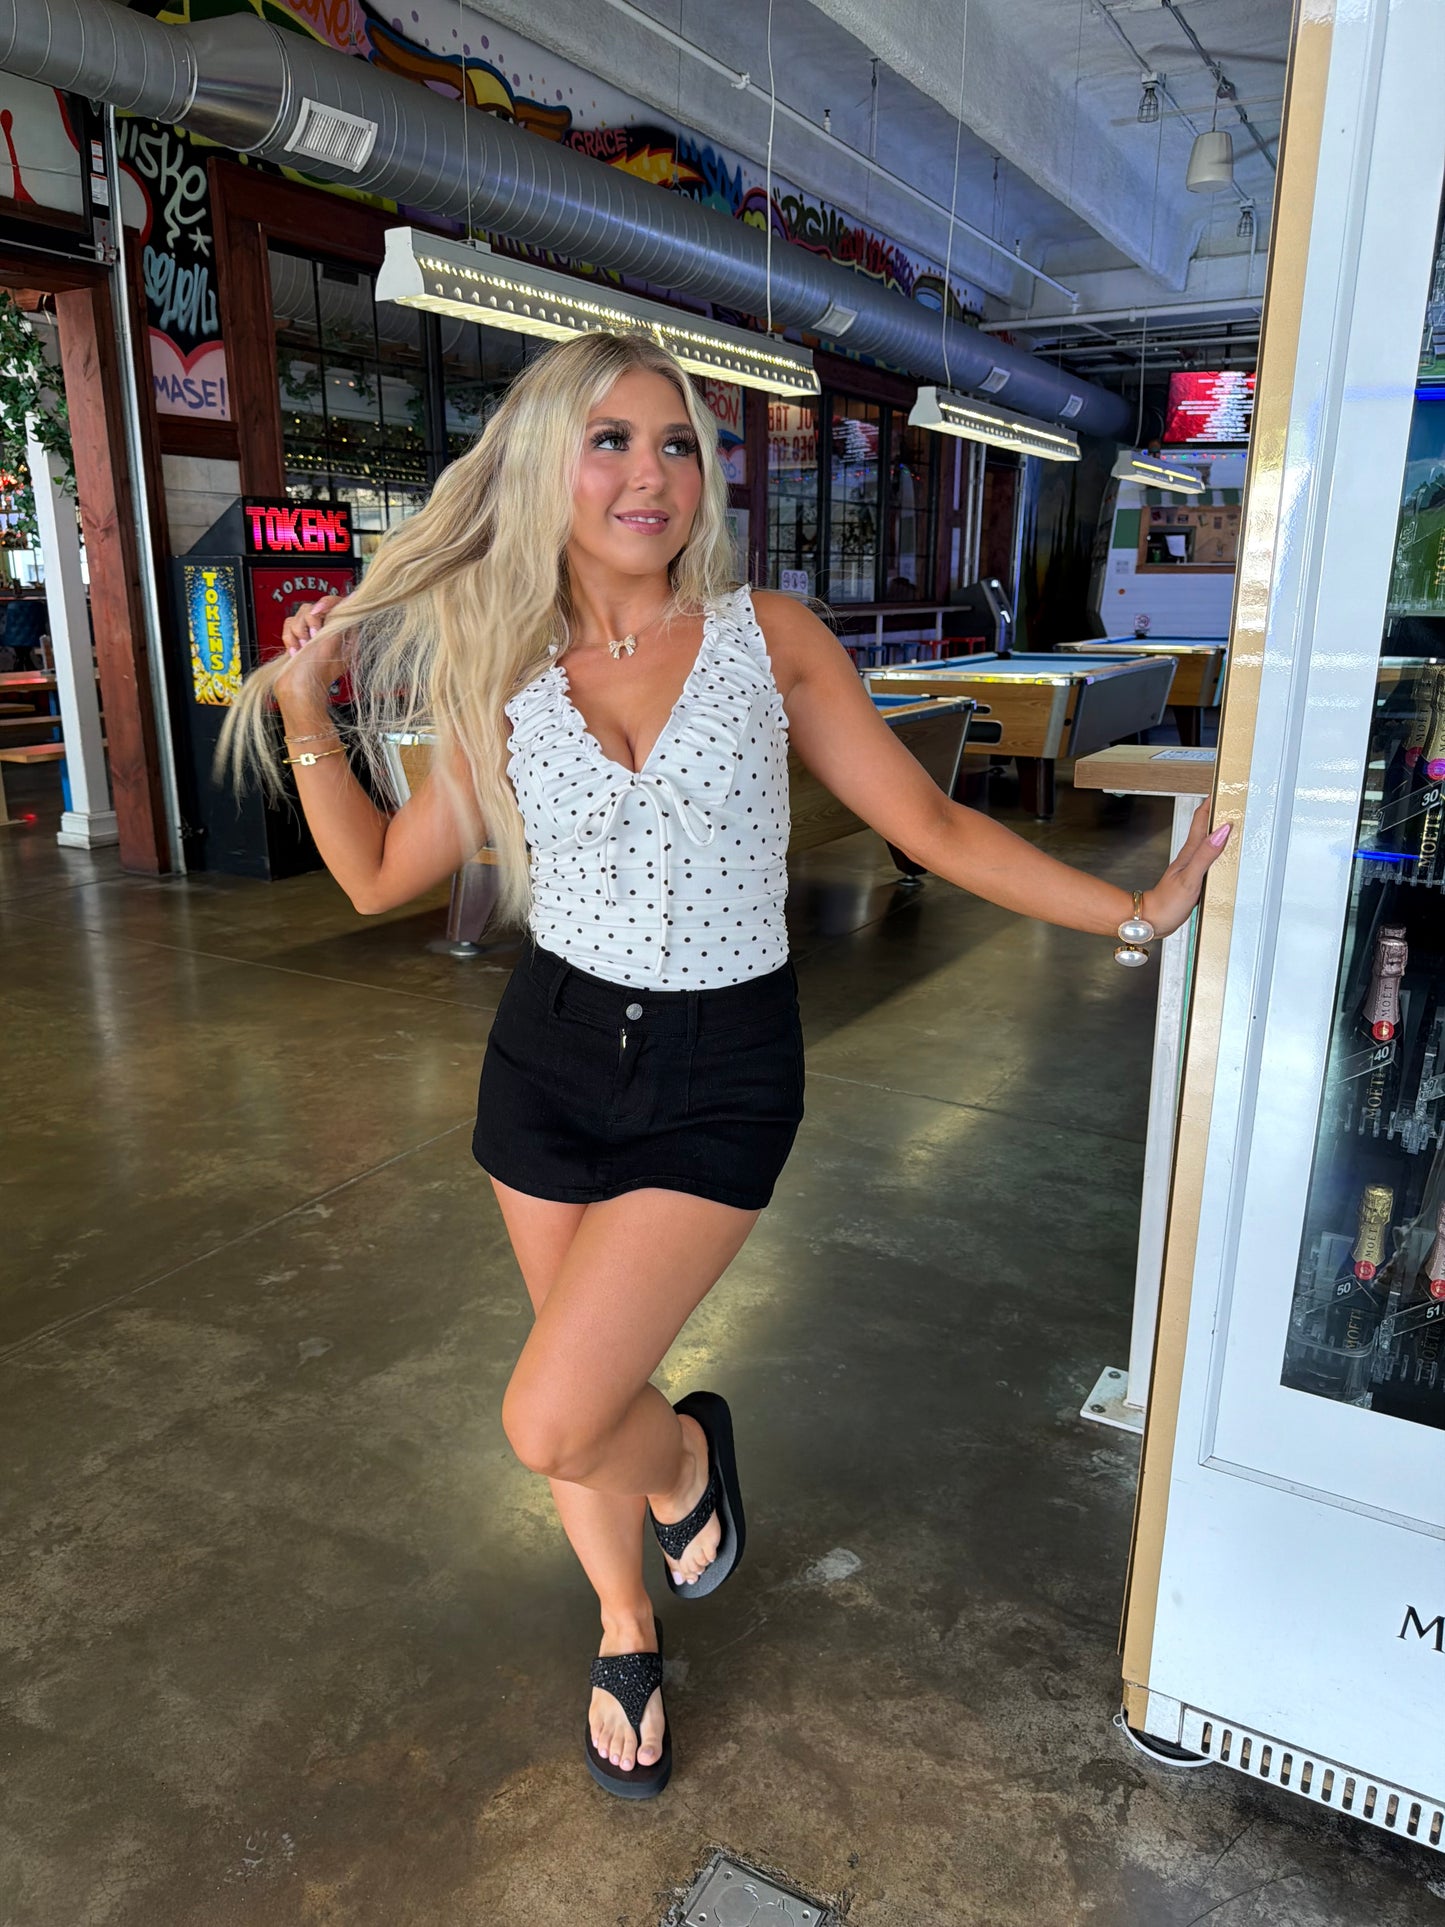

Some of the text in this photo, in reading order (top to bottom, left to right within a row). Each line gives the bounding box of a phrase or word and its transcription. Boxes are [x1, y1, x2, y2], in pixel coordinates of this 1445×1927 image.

[570, 127, 628, 158] GRACE
[153, 373, 226, 417] MASE!
[246, 506, 351, 552] TOKENS
[272, 576, 340, 603] TOKENS
[202, 572, 225, 671] TOKENS
[1421, 788, 1439, 807] 30
[1374, 1045, 1389, 1061] 40
[1337, 1282, 1351, 1296] 50
[1426, 1304, 1441, 1319] 51
